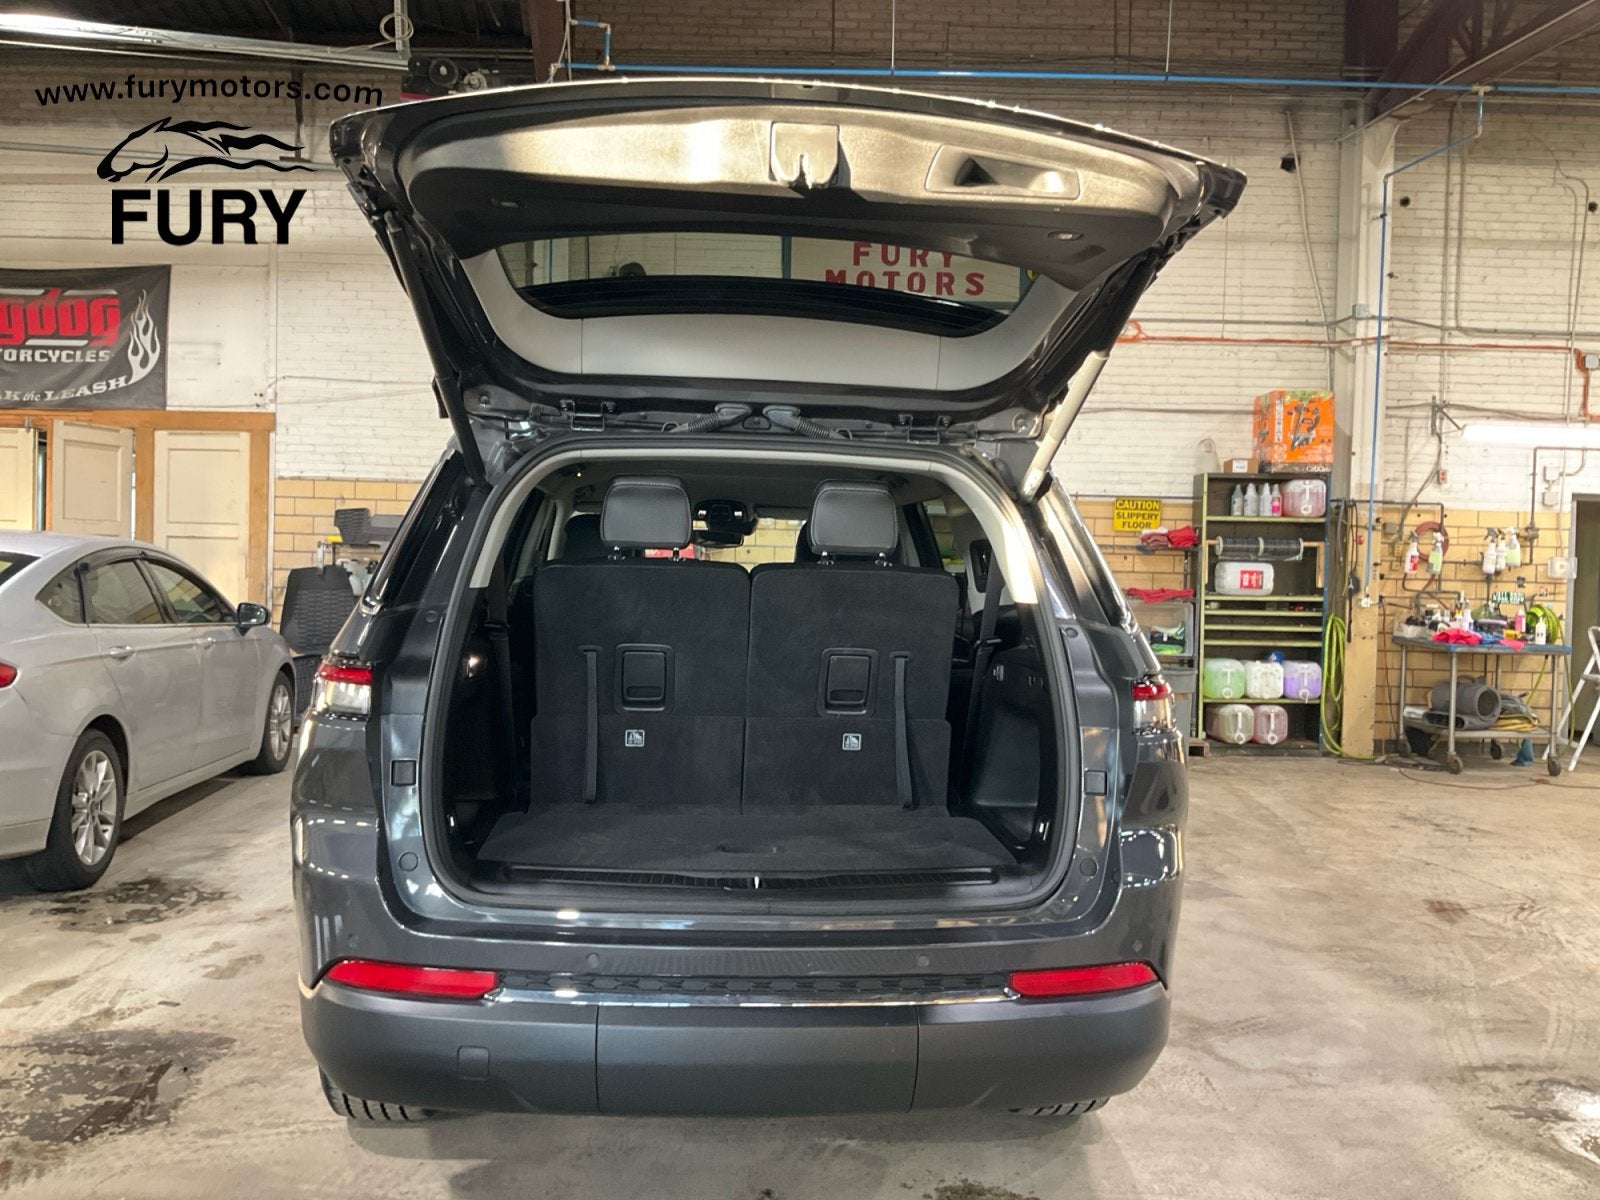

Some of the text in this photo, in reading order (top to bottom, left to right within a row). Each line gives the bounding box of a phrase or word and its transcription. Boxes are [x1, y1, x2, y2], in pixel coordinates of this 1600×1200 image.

[852, 241, 955, 268] FURY
[825, 269, 985, 296] MOTORS
[0, 348, 112, 363] ORCYCLES
[44, 375, 129, 401] LEASH
[1116, 500, 1160, 510] CAUTION
[1115, 511, 1160, 521] SLIPPERY
[1122, 520, 1152, 529] FLOOR
